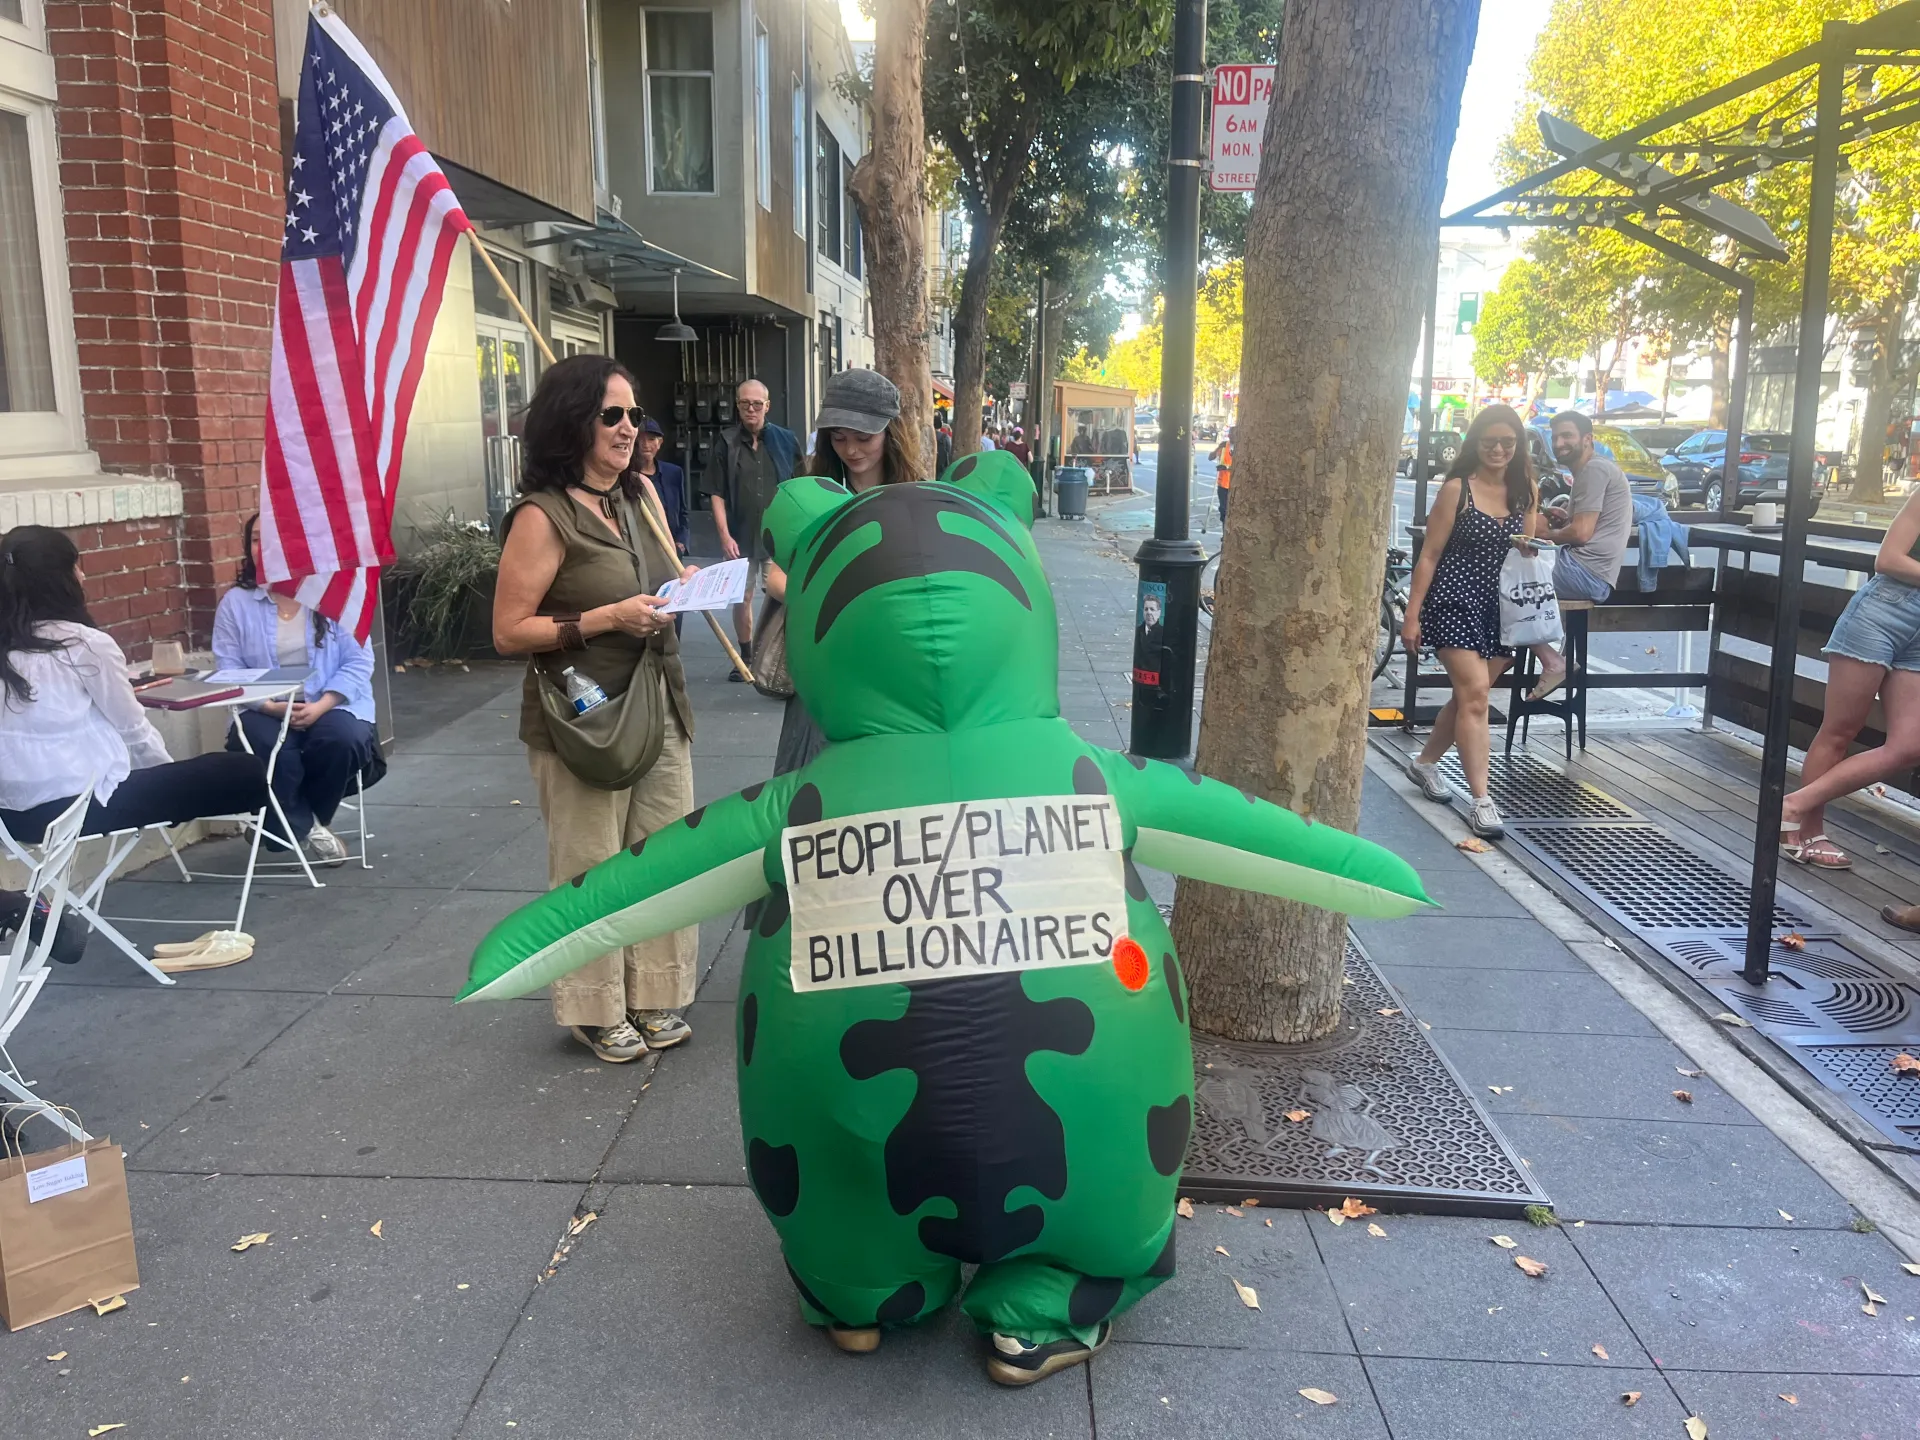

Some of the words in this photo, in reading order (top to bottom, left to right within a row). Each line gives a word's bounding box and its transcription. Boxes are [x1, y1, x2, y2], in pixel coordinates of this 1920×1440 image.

[1218, 70, 1247, 102] NO
[1226, 114, 1257, 133] 6AM
[1222, 142, 1254, 157] MON.
[1217, 173, 1257, 183] STREET
[788, 803, 1110, 884] PEOPLE/PLANET
[883, 866, 1013, 925] OVER
[809, 912, 1114, 983] BILLIONAIRES
